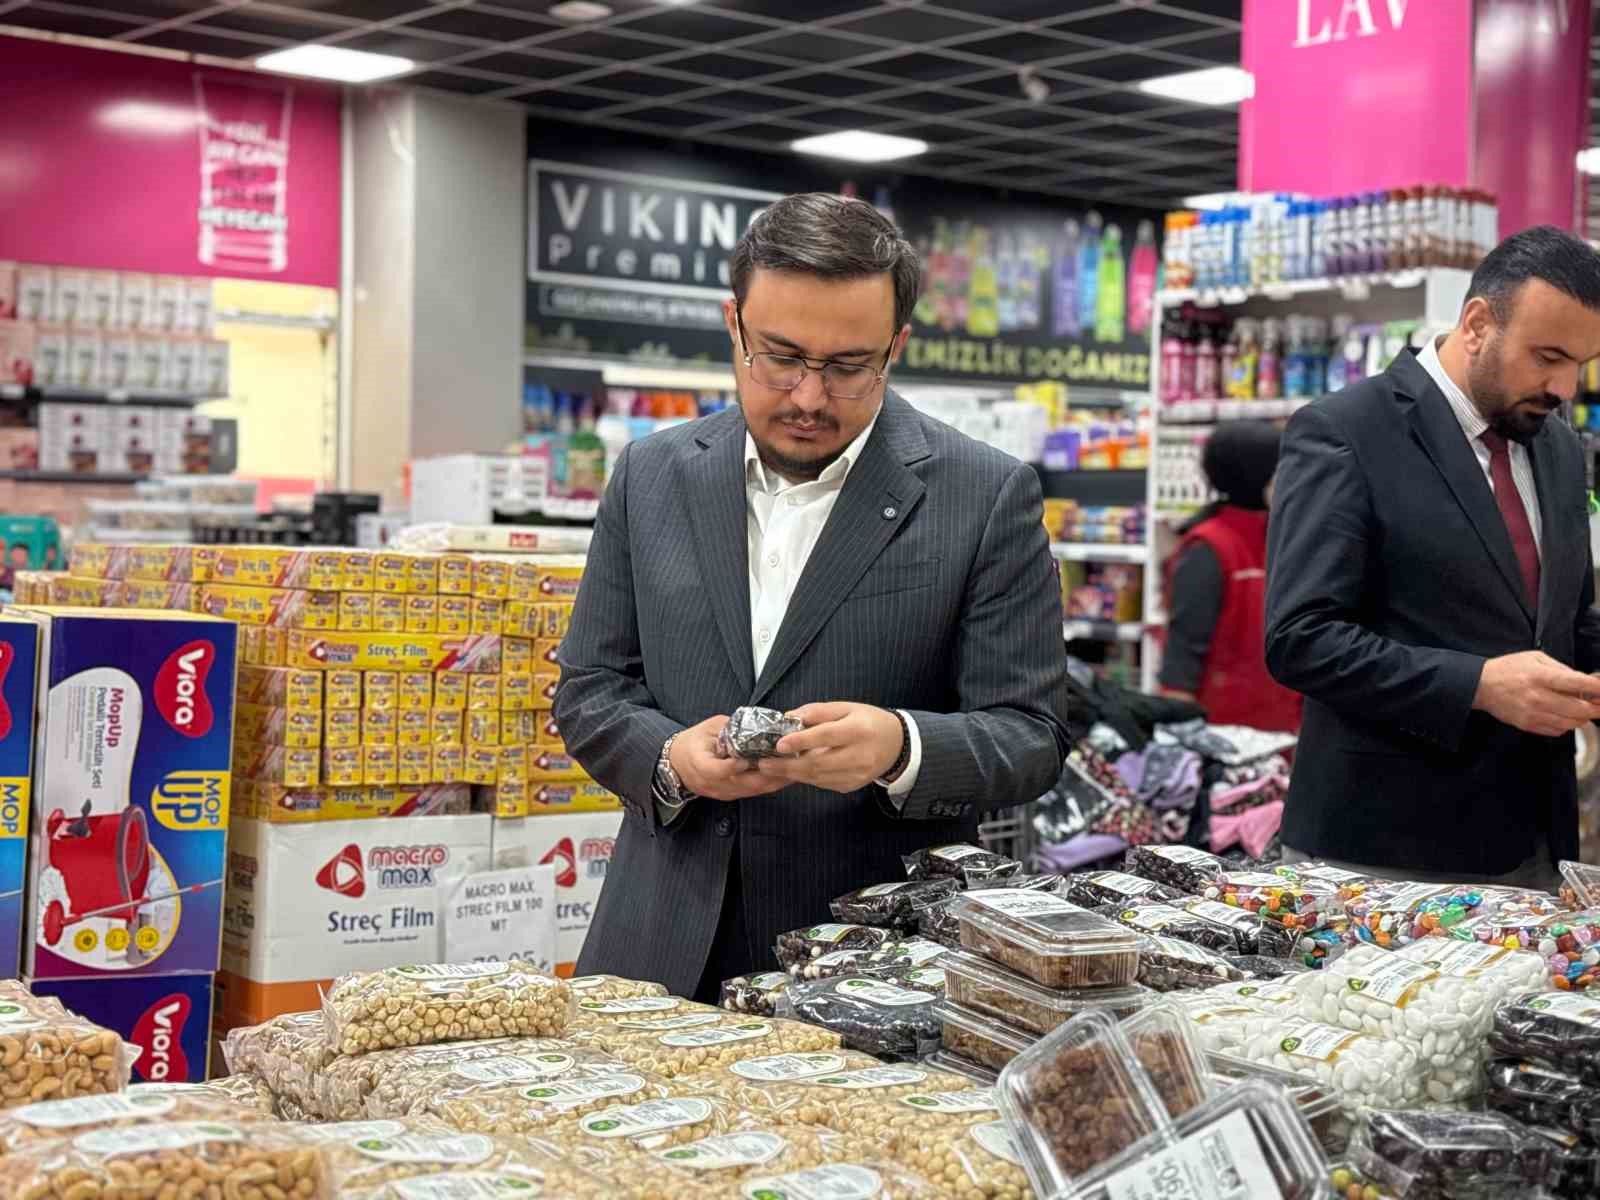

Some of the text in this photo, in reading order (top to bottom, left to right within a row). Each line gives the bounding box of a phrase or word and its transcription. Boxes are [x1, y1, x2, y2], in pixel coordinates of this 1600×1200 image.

[551, 180, 757, 250] VIKIN
[907, 335, 1023, 376] EMİZLİK
[105, 687, 124, 748] MopUp
[1, 783, 20, 834] MOP
[204, 778, 222, 825] MOP
[368, 846, 448, 870] macro
[378, 867, 436, 888] max
[465, 881, 535, 899] MACRO MAX
[495, 899, 522, 915] FILM
[525, 897, 544, 912] 100
[556, 901, 591, 927] treç
[328, 906, 434, 934] Streç Film
[490, 919, 508, 932] MT
